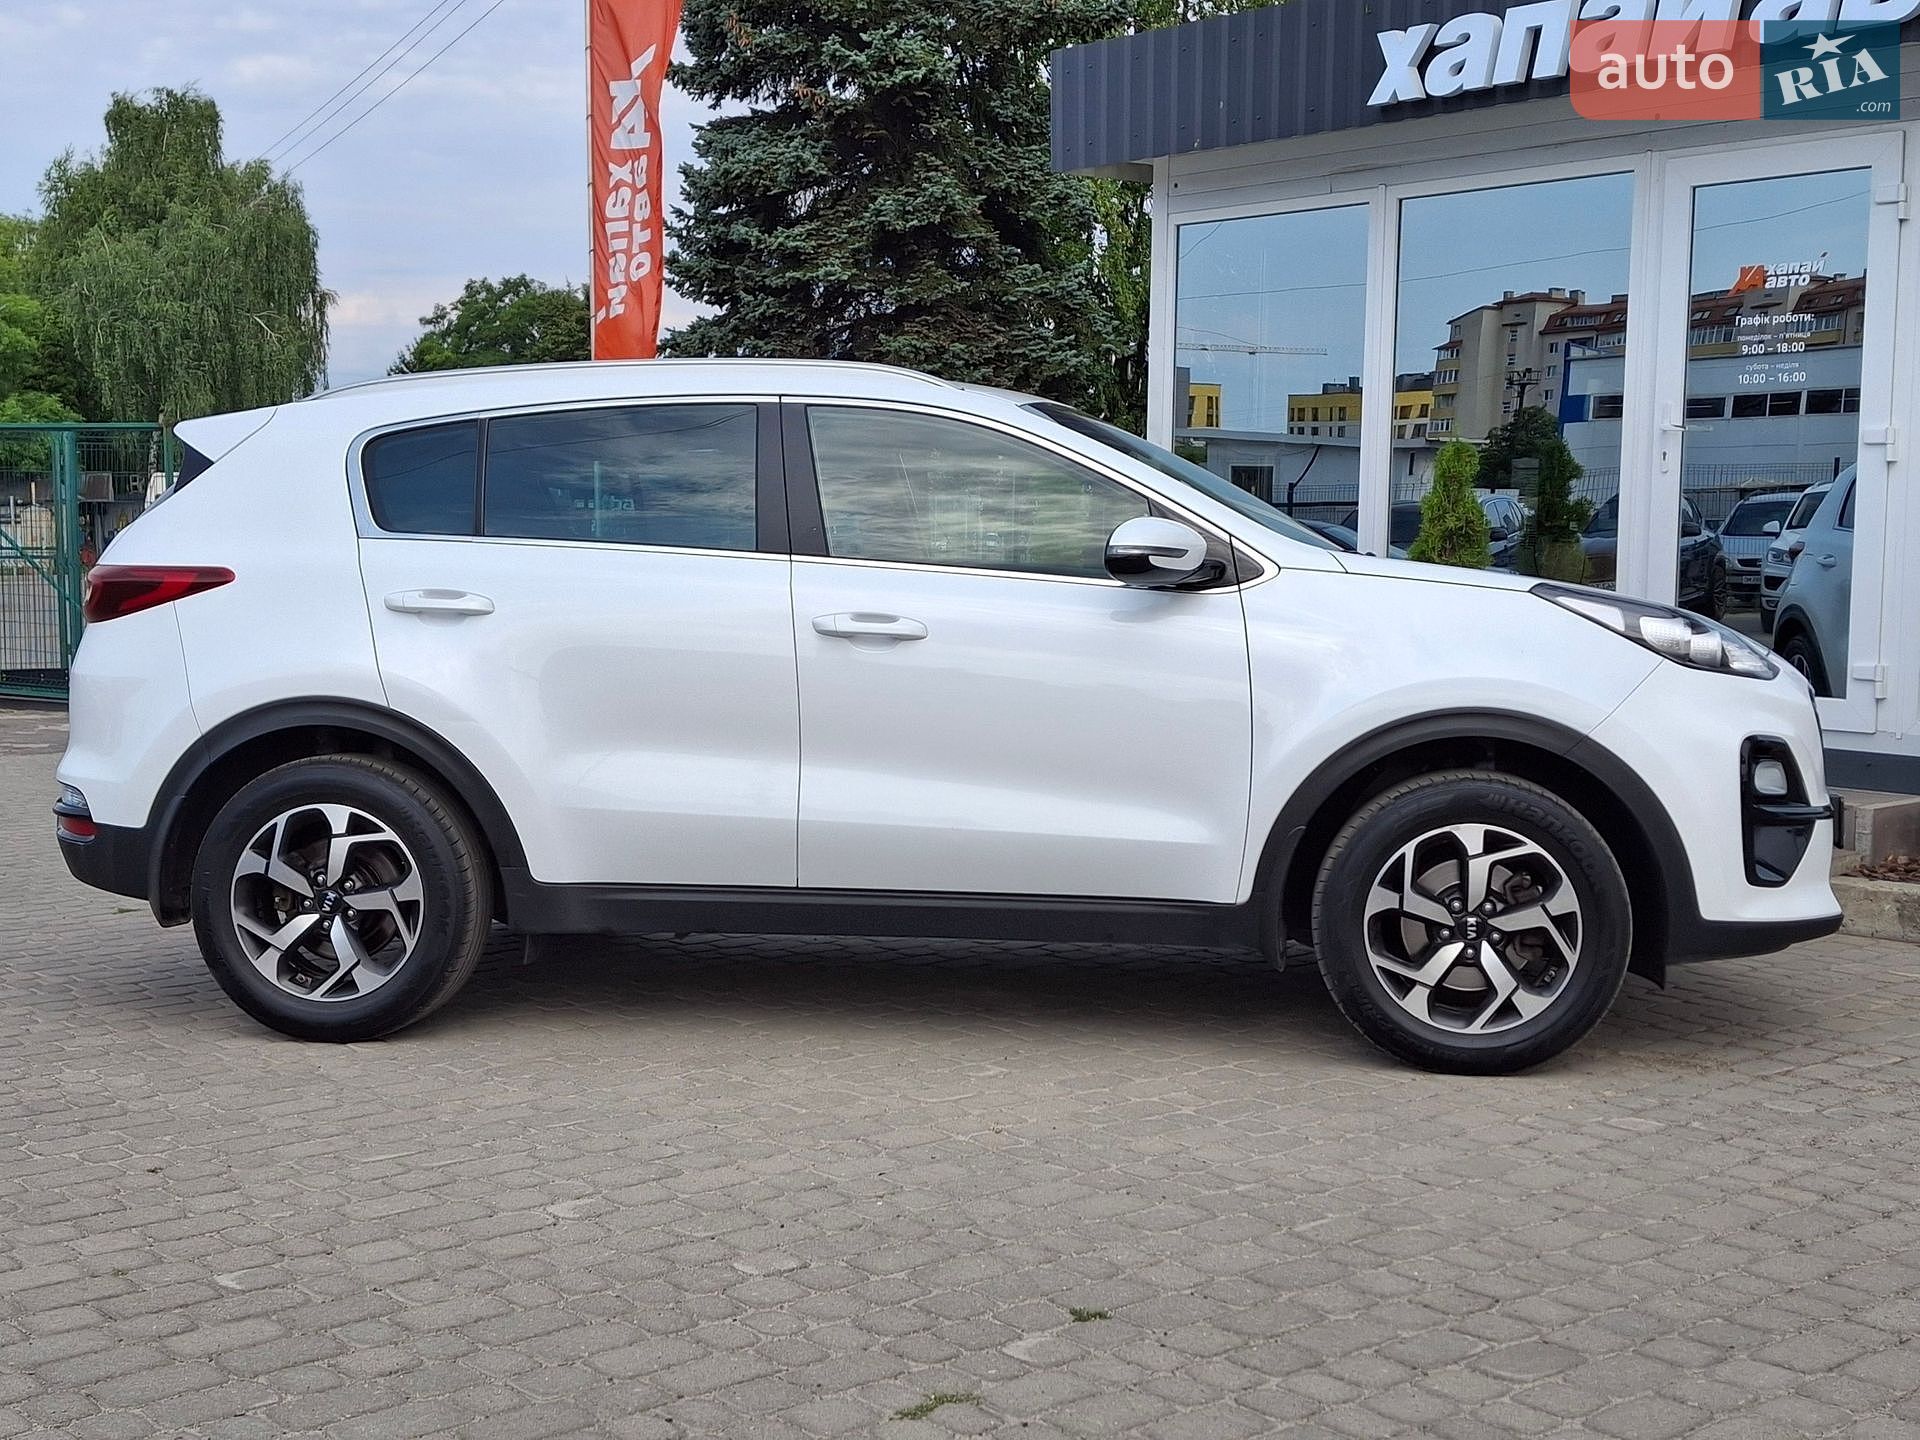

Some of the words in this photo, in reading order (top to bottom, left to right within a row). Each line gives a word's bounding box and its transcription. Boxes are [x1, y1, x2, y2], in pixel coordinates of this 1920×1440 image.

[1767, 251, 1828, 276] хапай
[1765, 274, 1810, 289] авто
[1735, 313, 1770, 328] Графік
[1772, 312, 1815, 326] роботи:
[1742, 343, 1765, 355] 9:00
[1776, 341, 1805, 353] 18:00
[1738, 373, 1766, 385] 10:00
[1778, 371, 1807, 383] 16:00
[1466, 917, 1477, 940] KIA
